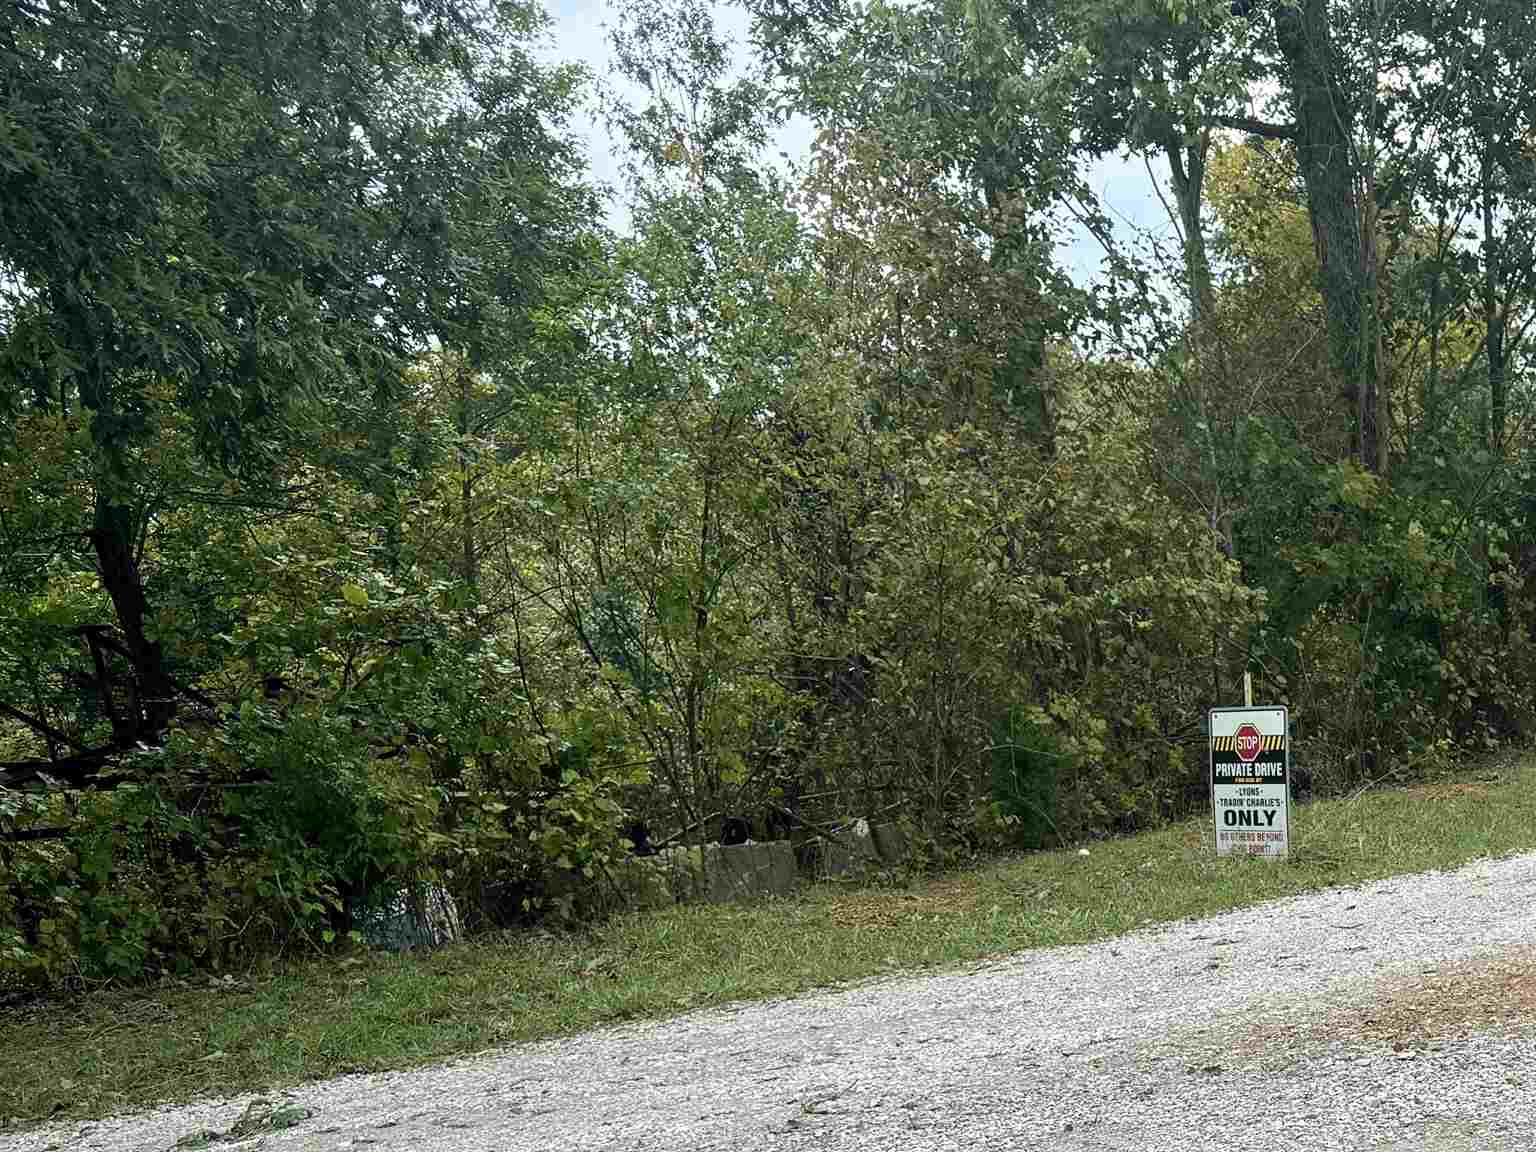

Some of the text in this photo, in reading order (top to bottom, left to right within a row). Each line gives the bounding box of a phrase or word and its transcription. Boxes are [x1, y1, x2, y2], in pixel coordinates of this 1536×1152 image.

[1237, 736, 1258, 750] STOP
[1215, 762, 1283, 777] PRIVATE DRIVE
[1224, 809, 1277, 827] ONLY
